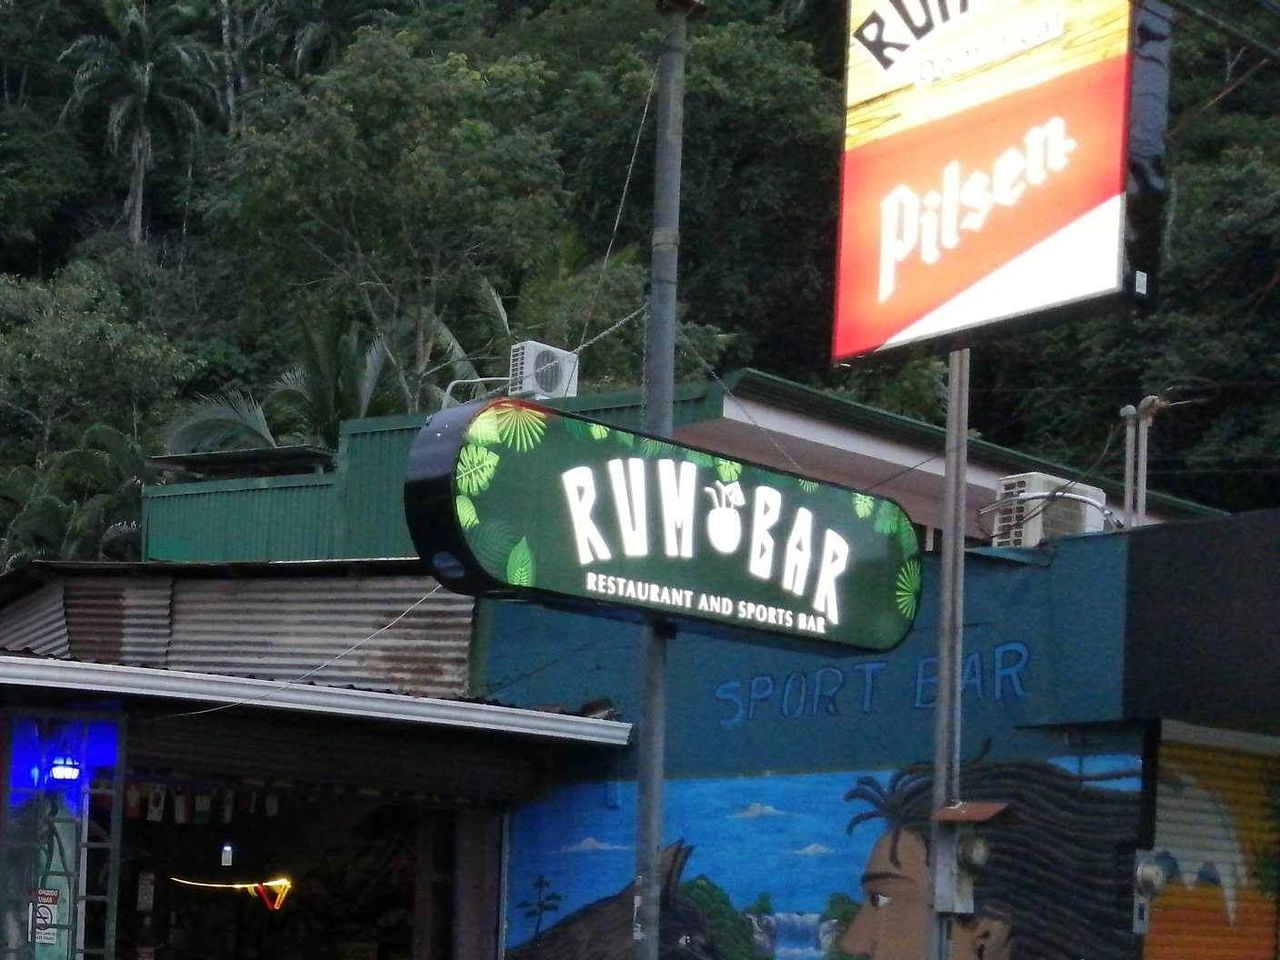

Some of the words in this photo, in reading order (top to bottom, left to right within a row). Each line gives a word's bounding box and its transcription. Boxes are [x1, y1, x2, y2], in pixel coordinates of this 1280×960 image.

[853, 0, 970, 70] RU
[877, 116, 1078, 304] Pilsen
[561, 457, 697, 565] RUM
[748, 485, 850, 625] BAR
[586, 571, 694, 610] RESTAURANT
[698, 592, 734, 617] AND
[738, 602, 794, 629] SPORTS
[798, 613, 827, 635] BAR
[715, 661, 888, 727] SPORT
